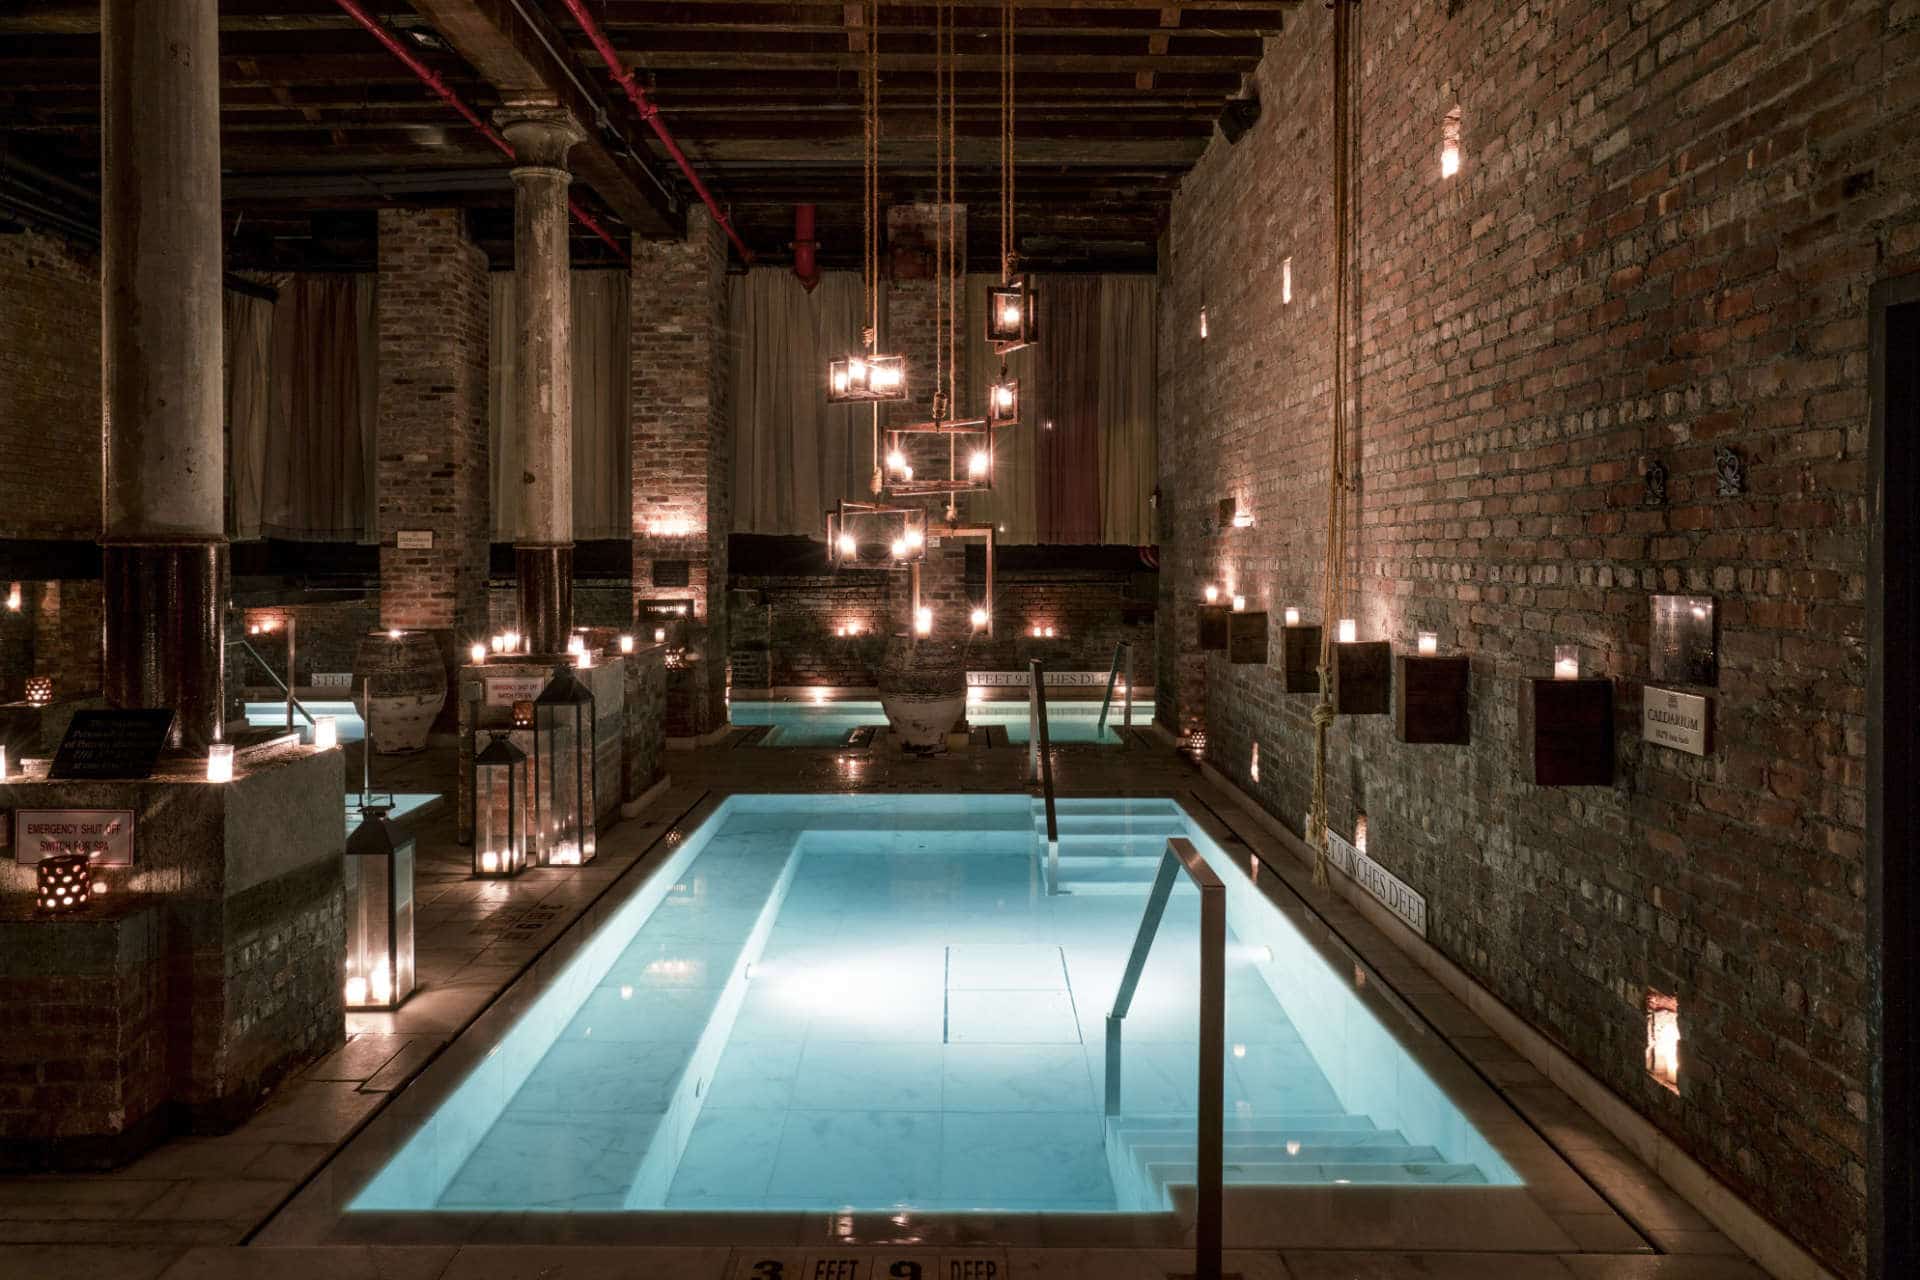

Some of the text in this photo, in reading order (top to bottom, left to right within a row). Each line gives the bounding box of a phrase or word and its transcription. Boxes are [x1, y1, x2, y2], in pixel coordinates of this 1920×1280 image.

[1647, 708, 1698, 731] CALDARIUM
[27, 823, 121, 835] EMERGENCY SHUT OFF
[39, 840, 109, 852] SWITCH FOR SPA
[1345, 847, 1386, 900] INCHES
[751, 1260, 997, 1280] 3 FEET 9 DEEP
